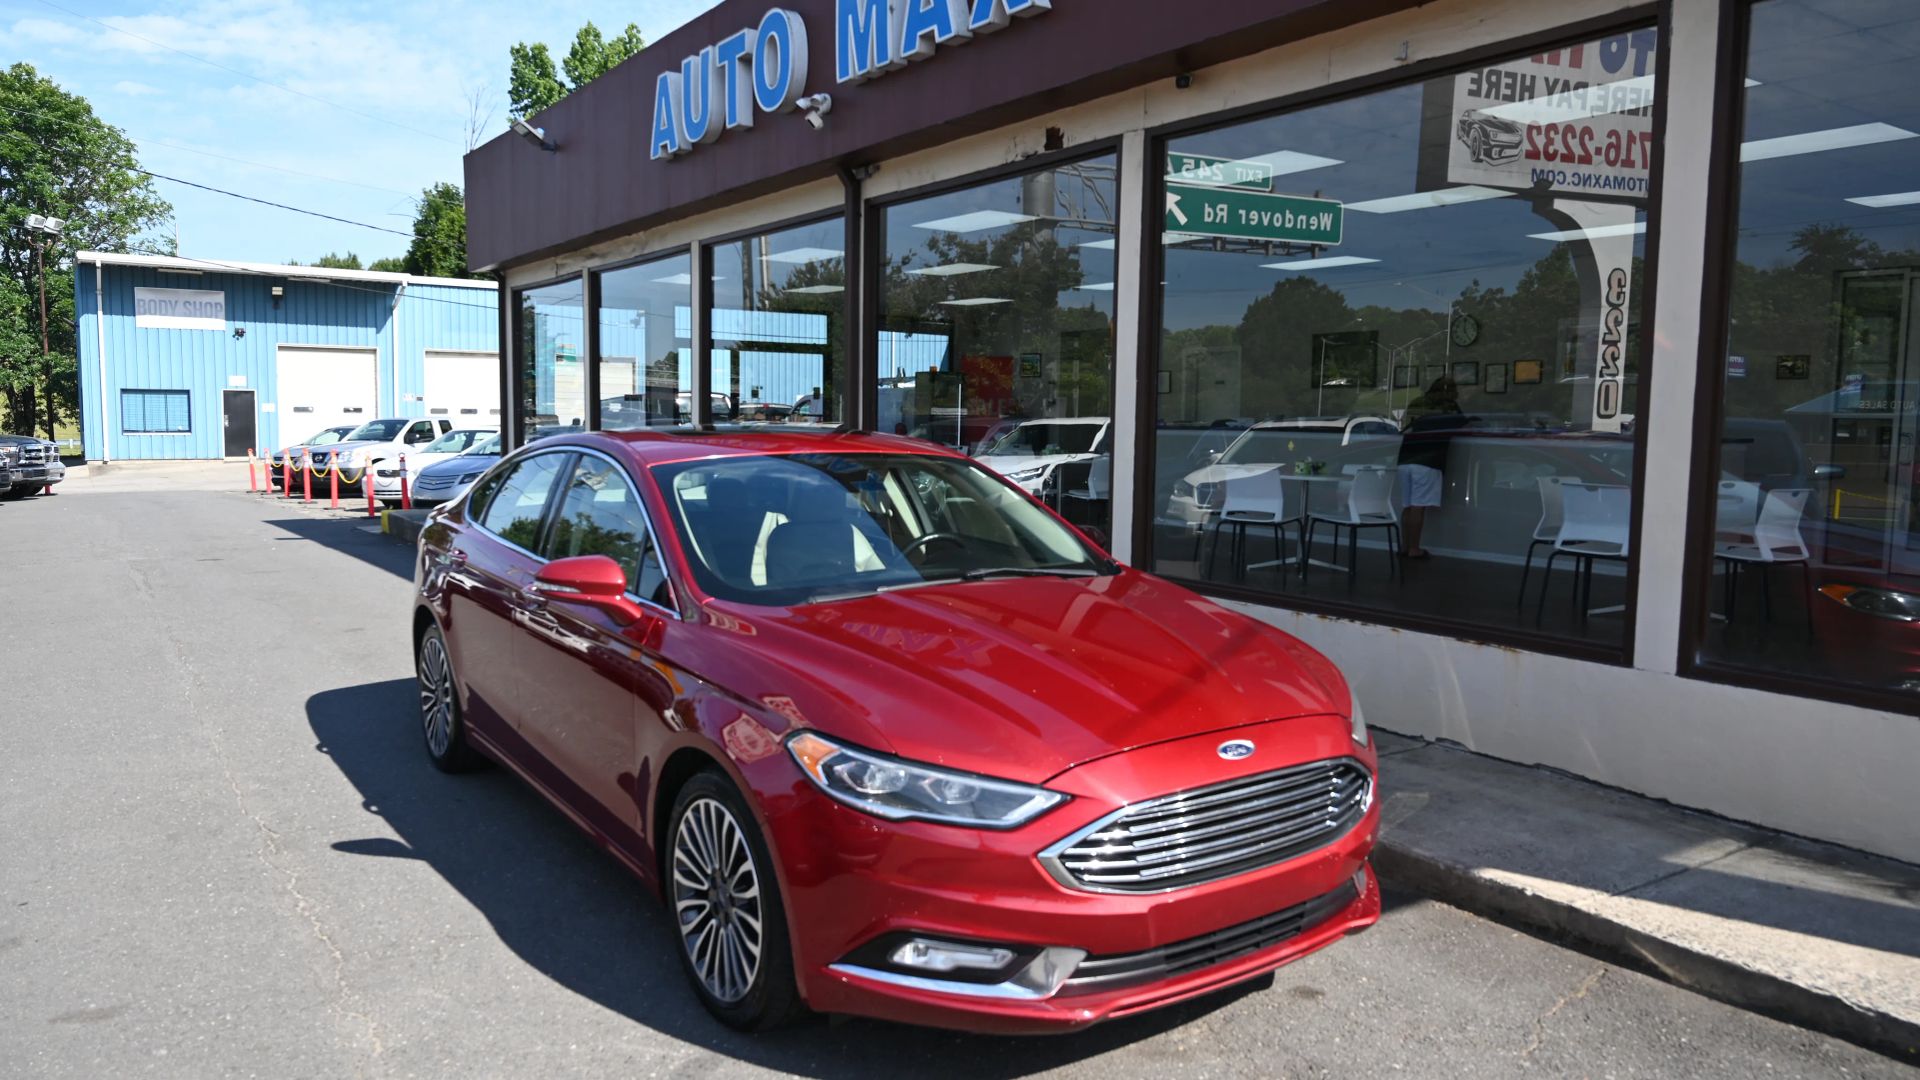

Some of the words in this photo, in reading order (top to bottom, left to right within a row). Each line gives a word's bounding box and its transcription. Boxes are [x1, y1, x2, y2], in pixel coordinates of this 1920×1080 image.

[650, 7, 801, 161] AUTO
[835, 0, 1047, 84] MA
[136, 298, 178, 316] BODY
[183, 300, 223, 318] SHOP
